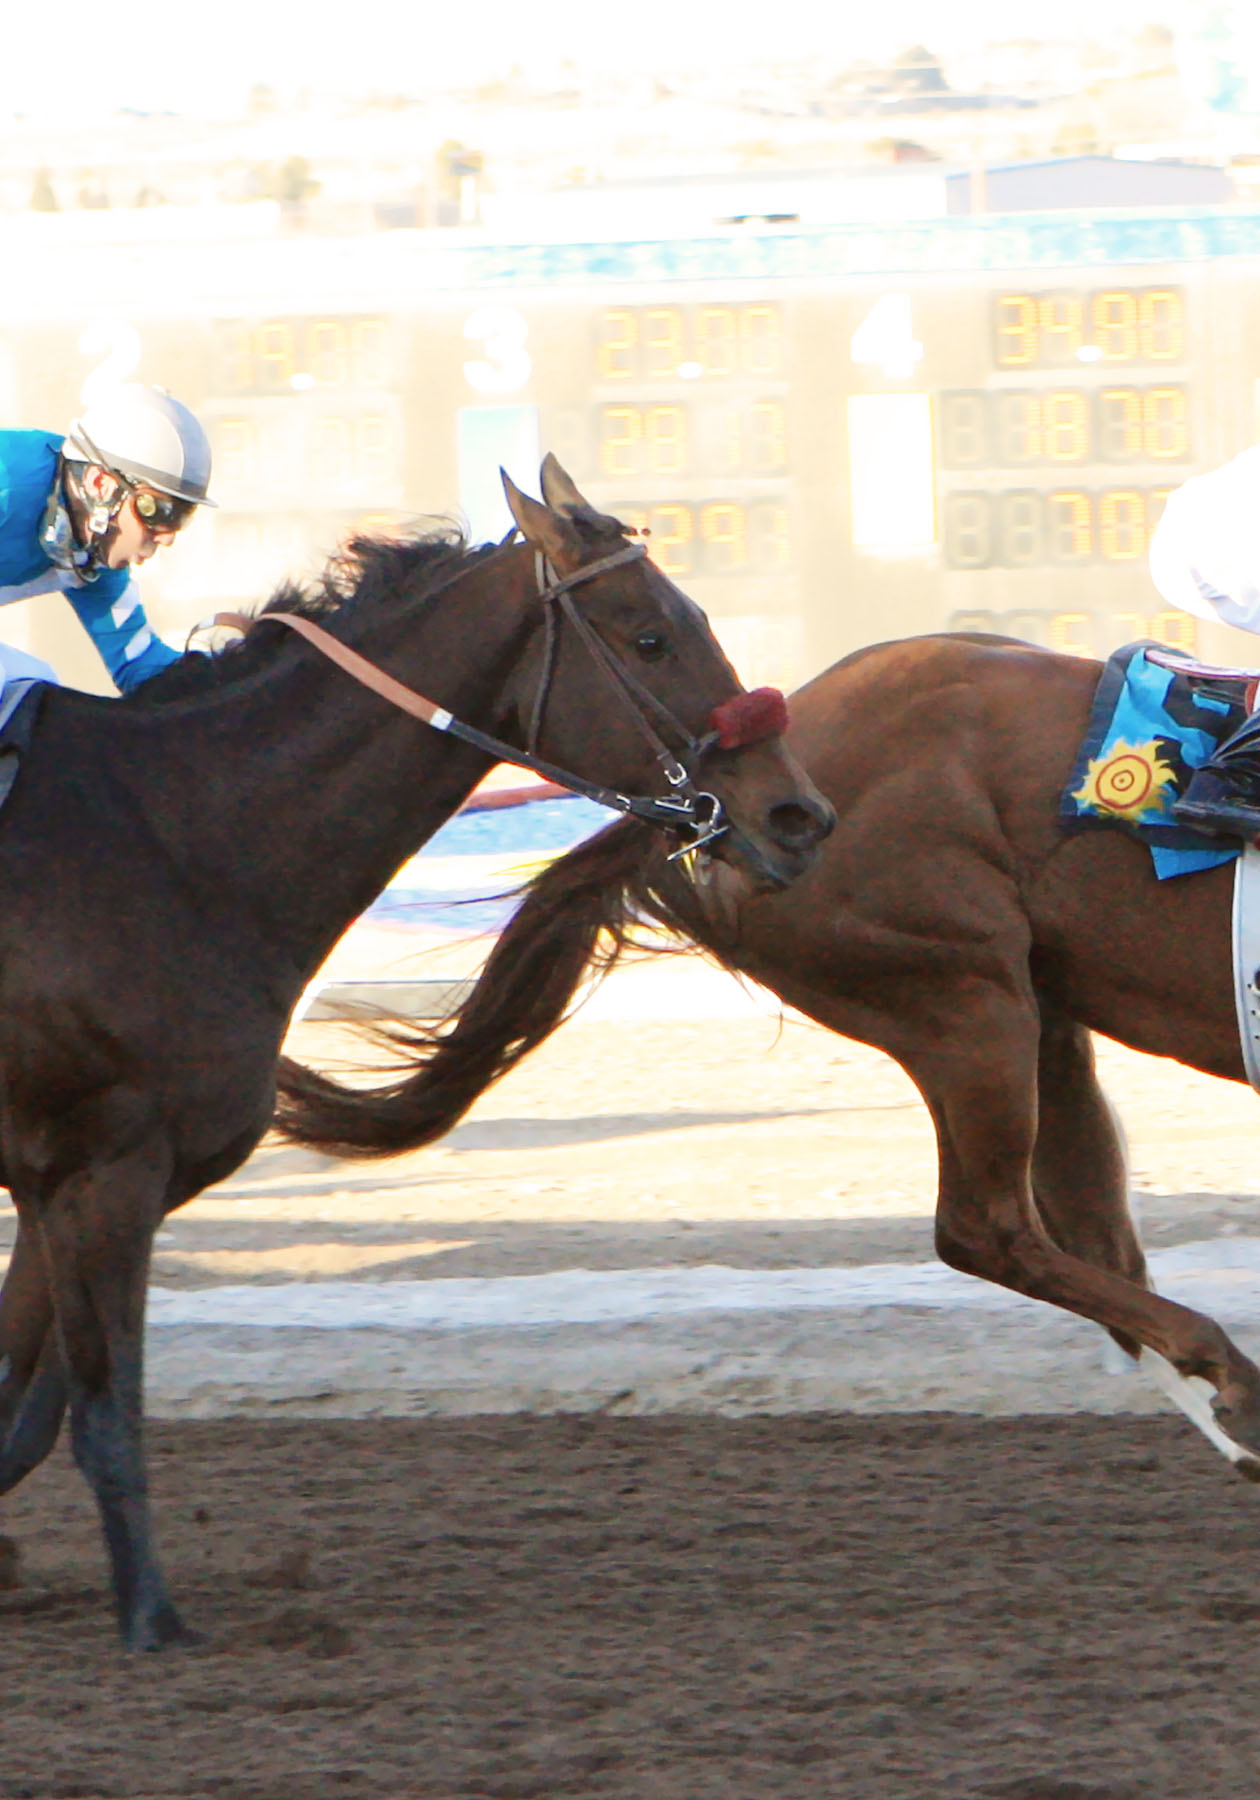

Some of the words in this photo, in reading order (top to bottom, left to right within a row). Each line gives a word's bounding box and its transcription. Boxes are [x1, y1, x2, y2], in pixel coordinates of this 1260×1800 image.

[78, 317, 143, 403] 2
[463, 307, 532, 393] 3
[851, 293, 925, 377] 4
[995, 287, 1186, 367] 34.80
